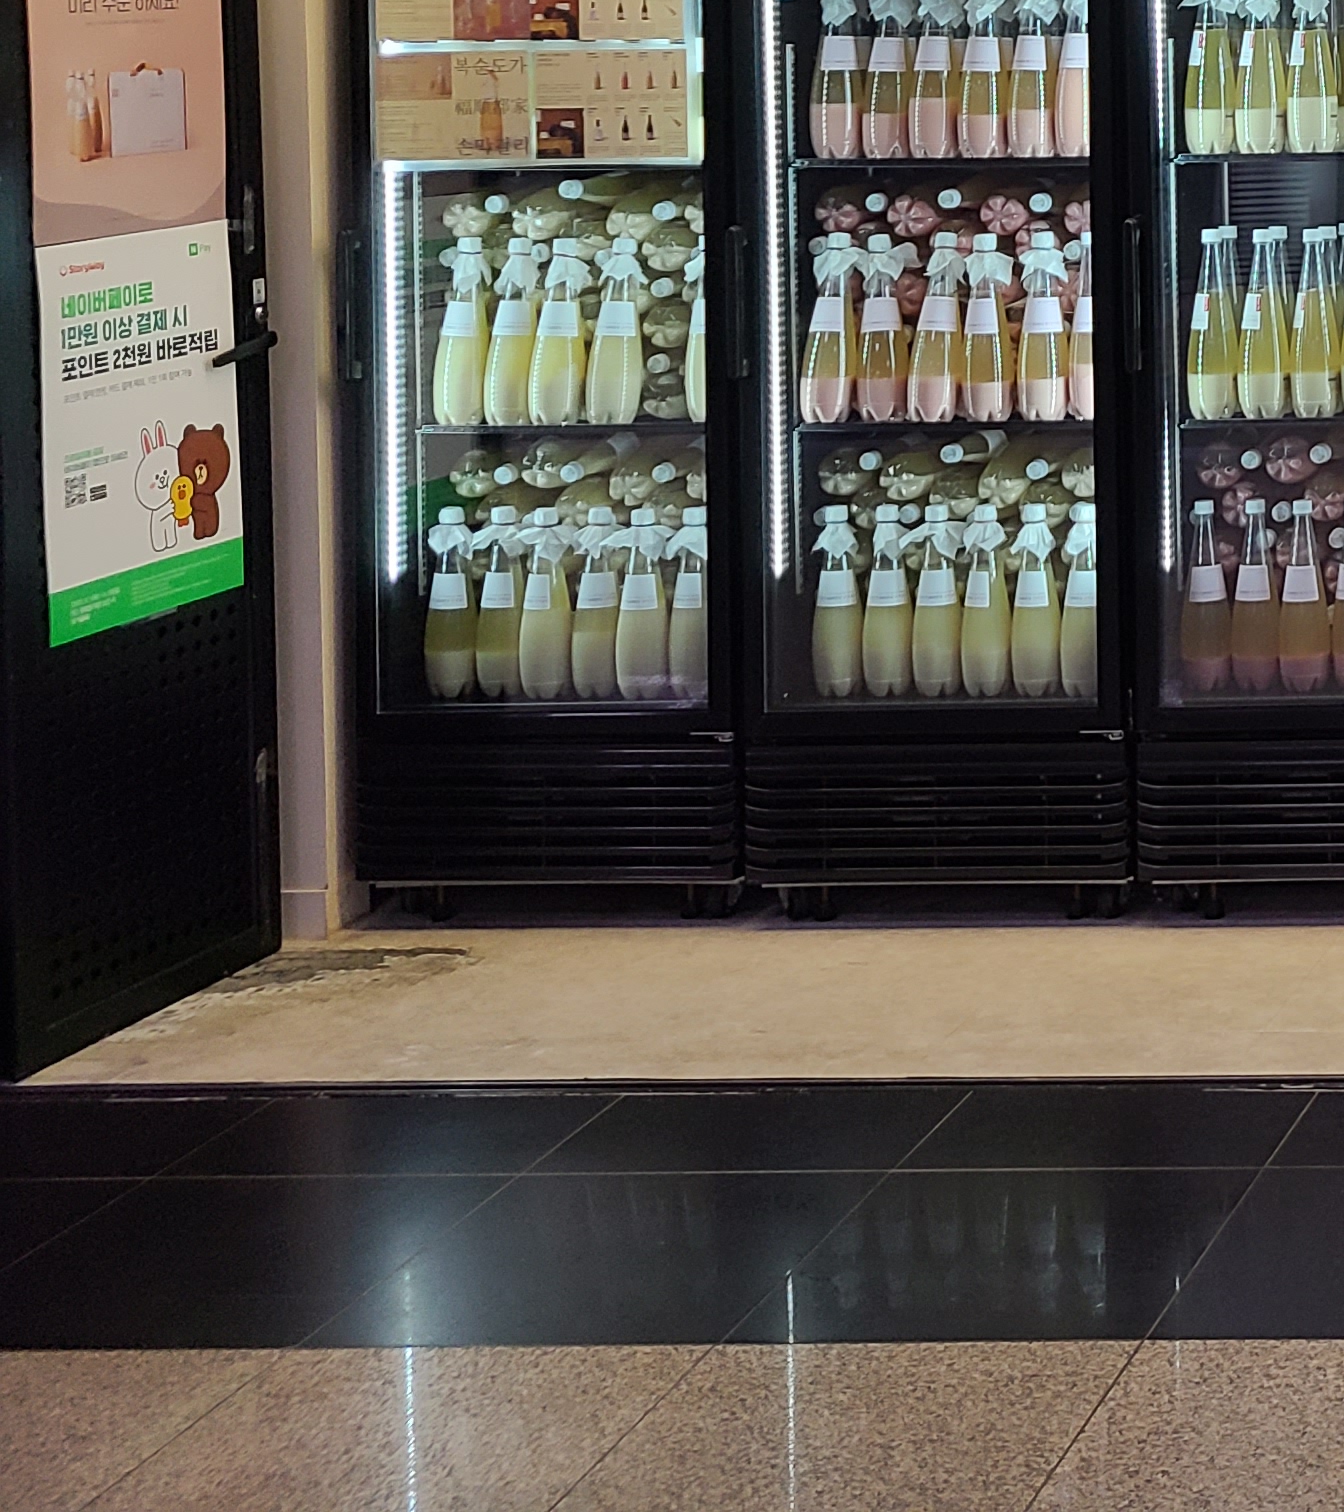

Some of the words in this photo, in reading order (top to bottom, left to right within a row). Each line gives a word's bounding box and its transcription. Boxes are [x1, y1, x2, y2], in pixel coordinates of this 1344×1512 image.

[61, 281, 154, 319] 네이버페이로
[61, 321, 98, 350] 1만원
[102, 315, 133, 342] 이상
[136, 308, 167, 334] 결제
[172, 304, 188, 327] 시
[61, 351, 110, 382] 포인트
[113, 341, 152, 370] 2천원
[157, 329, 219, 362] 바로적립
